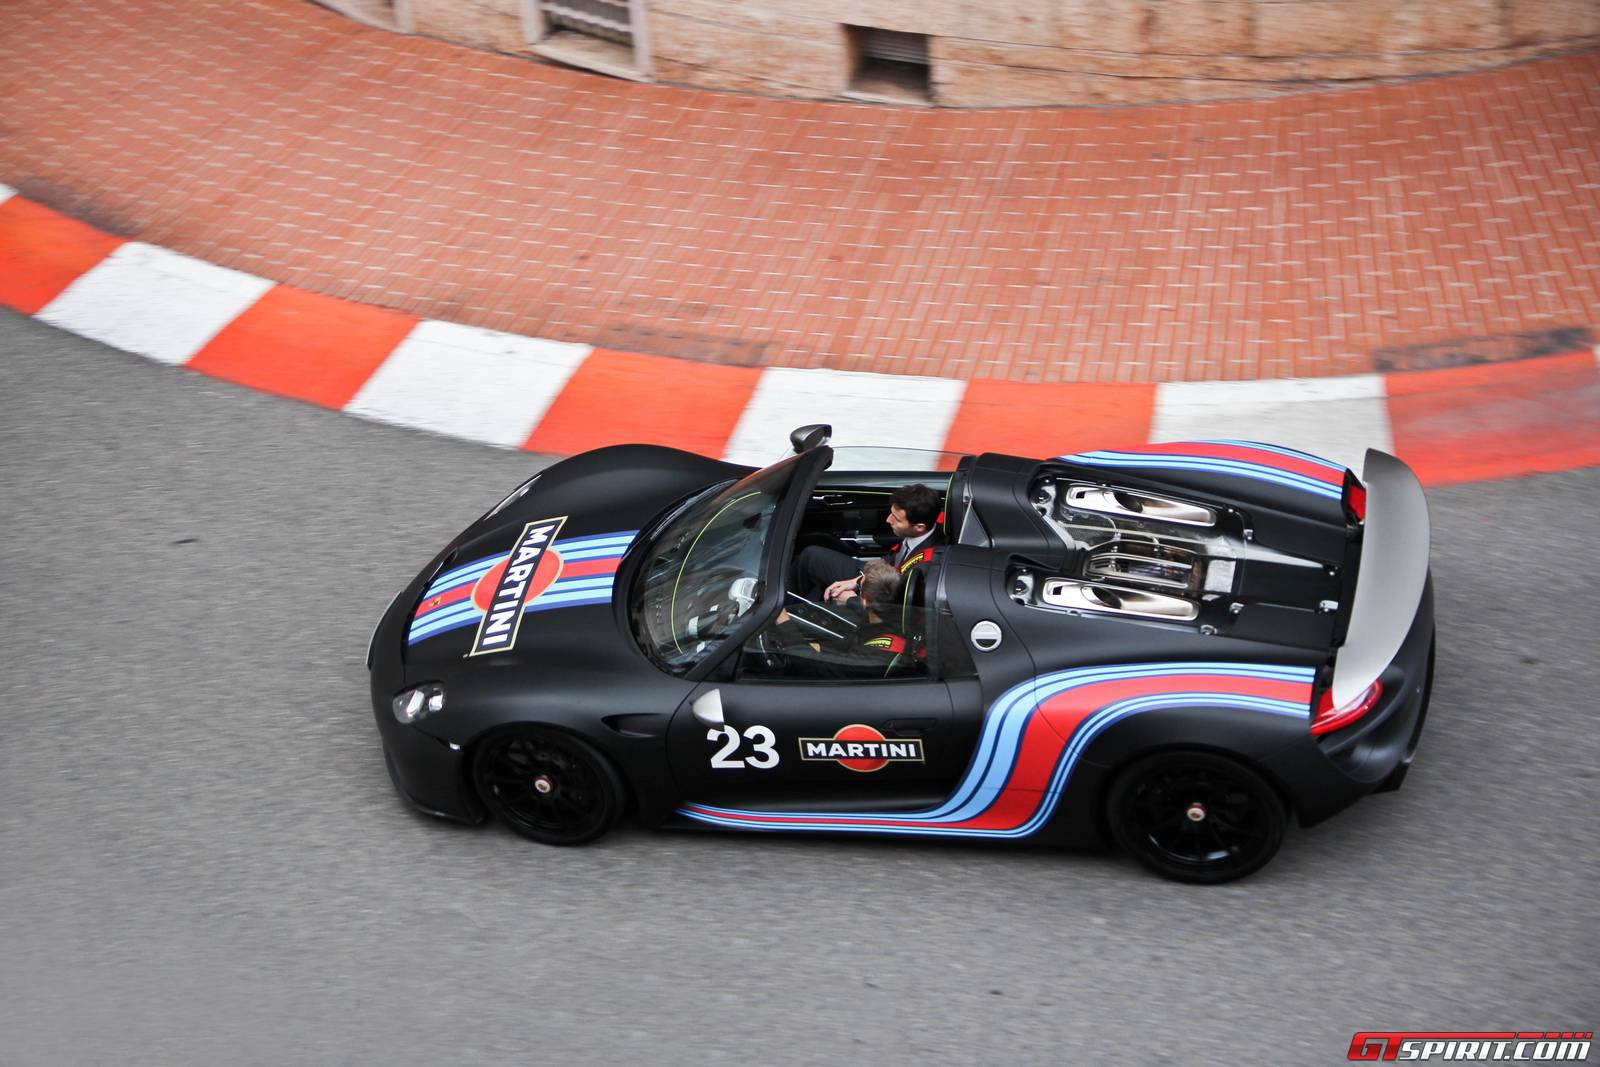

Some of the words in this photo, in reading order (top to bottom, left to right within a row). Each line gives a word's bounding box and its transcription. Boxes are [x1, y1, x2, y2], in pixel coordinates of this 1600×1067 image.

[482, 524, 555, 646] MARTINI
[706, 725, 780, 769] 23
[806, 742, 917, 758] MARTINI
